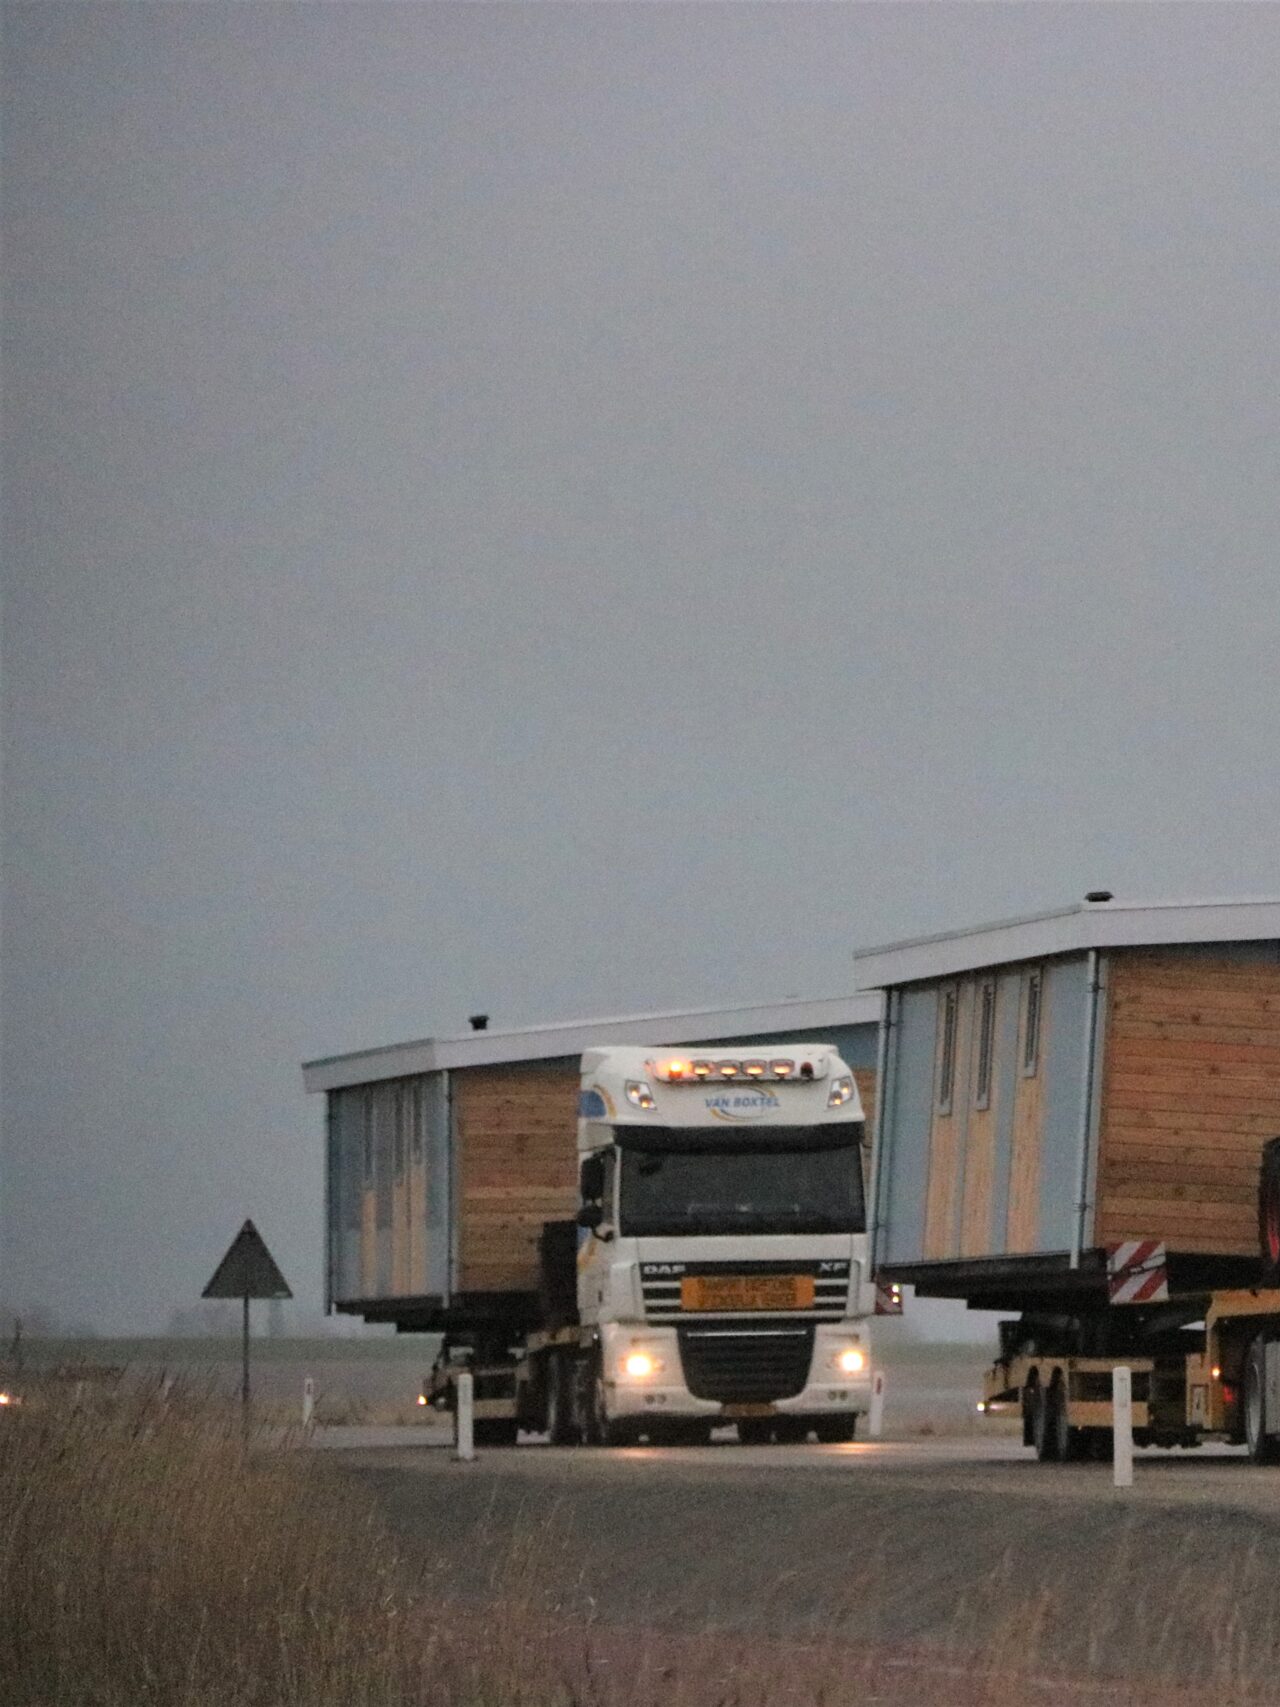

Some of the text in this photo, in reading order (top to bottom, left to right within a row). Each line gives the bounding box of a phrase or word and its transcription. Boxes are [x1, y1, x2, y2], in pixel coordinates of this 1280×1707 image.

[705, 1096, 780, 1108] VAN BOXTEL
[643, 1265, 686, 1275] DAF
[819, 1261, 848, 1272] XF
